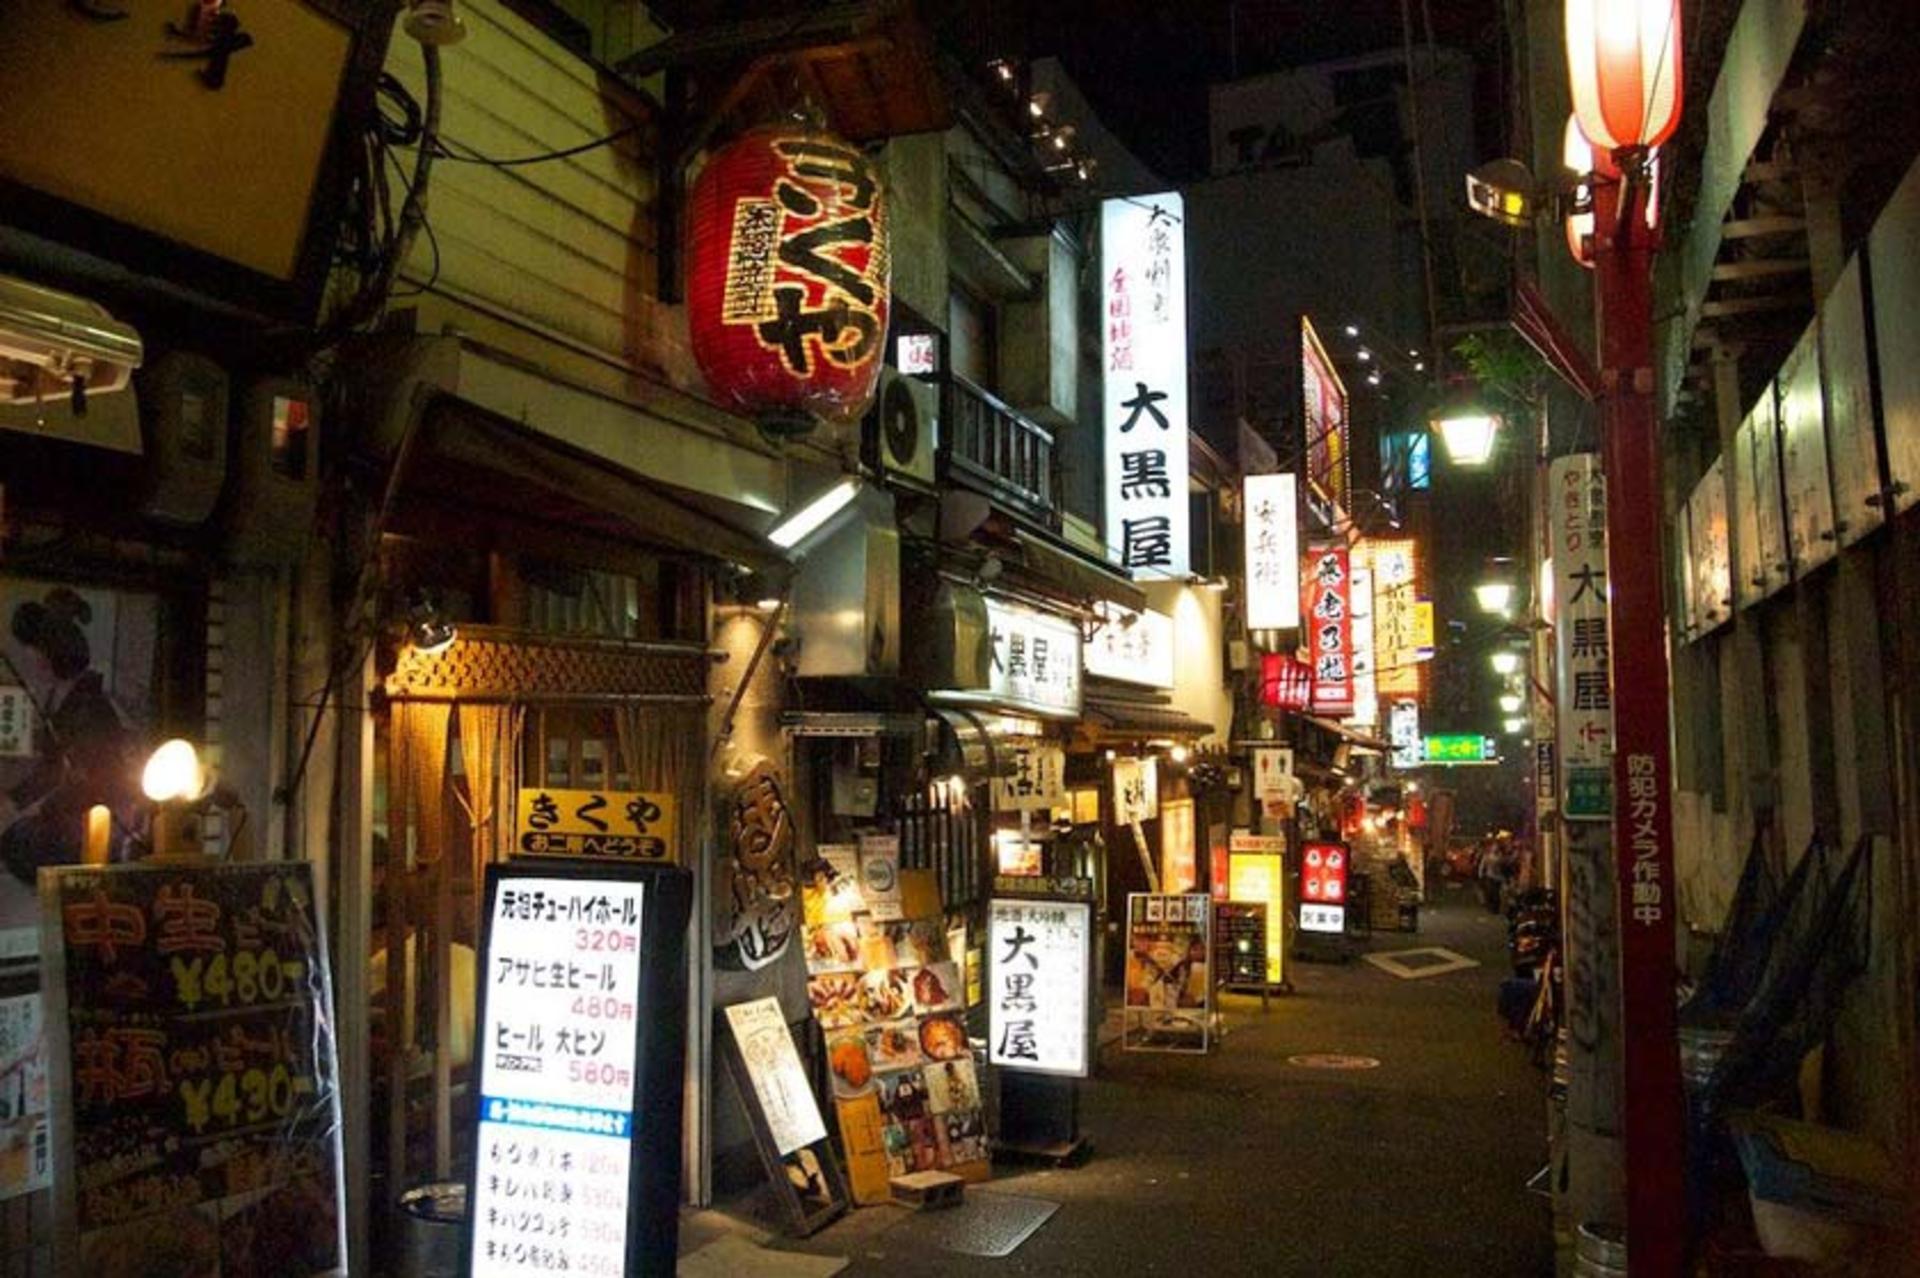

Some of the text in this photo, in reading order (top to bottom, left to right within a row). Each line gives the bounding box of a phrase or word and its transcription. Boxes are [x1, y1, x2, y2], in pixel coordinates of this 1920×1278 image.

[1120, 381, 1172, 568] 大黒屋
[1564, 469, 1582, 552] やきとり
[987, 624, 1050, 685] 大黒屋
[1568, 562, 1611, 711] 大黒屋
[528, 792, 662, 833] きくや
[1626, 753, 1662, 927] 防犯カメラ作動中
[575, 928, 637, 953] 320円
[570, 995, 632, 1021] 480円
[997, 924, 1040, 1062] 大黒屋
[568, 1059, 630, 1087] 580円
